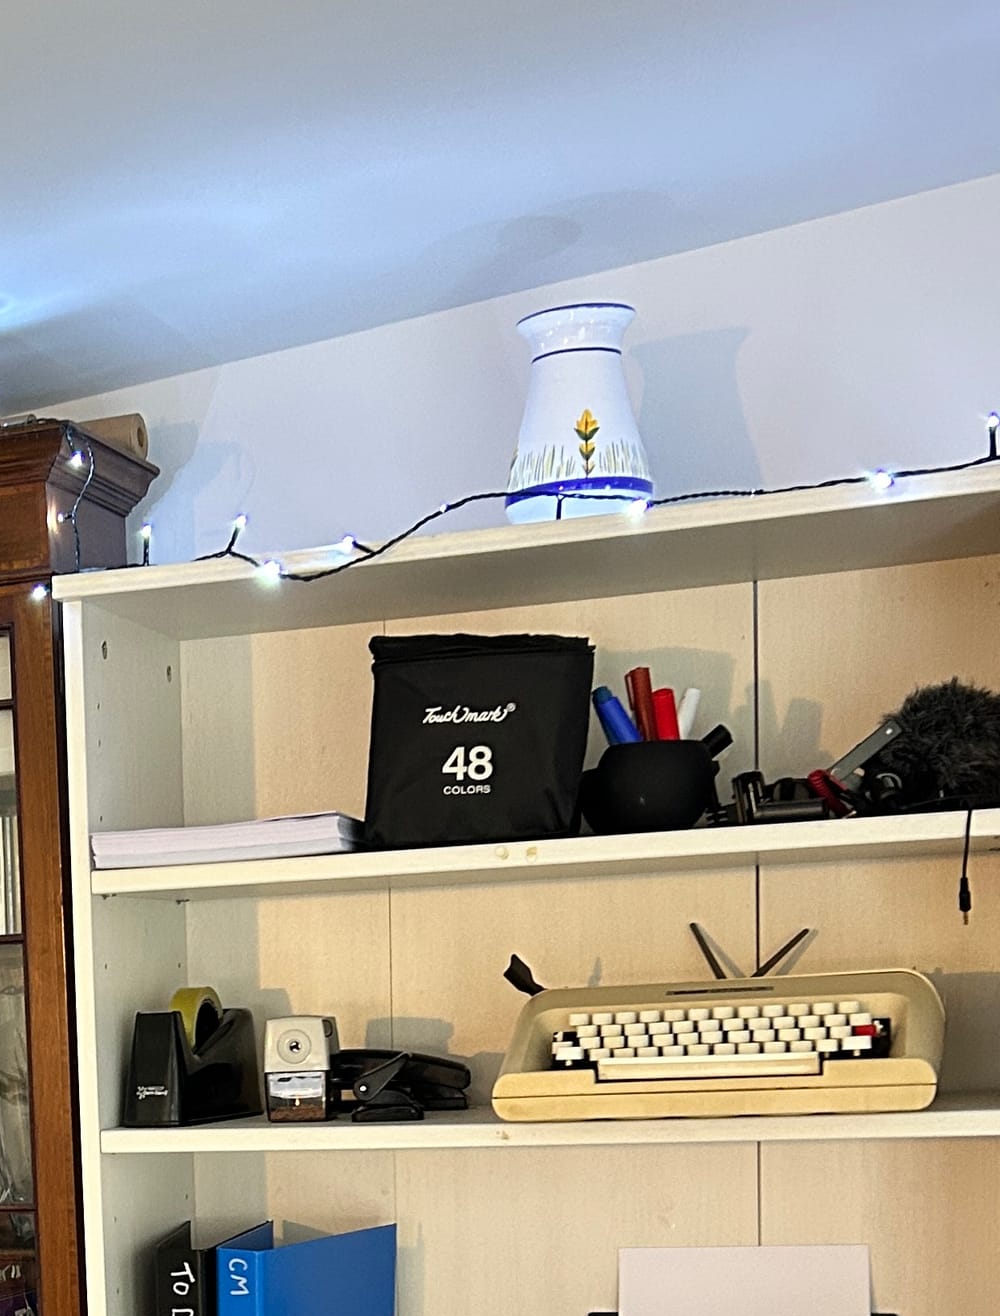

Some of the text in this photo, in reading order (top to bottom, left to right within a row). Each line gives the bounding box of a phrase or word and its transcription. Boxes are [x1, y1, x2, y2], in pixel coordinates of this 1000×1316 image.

[442, 745, 493, 781] 48
[443, 785, 491, 796] COLORS
[228, 1258, 250, 1296] CM
